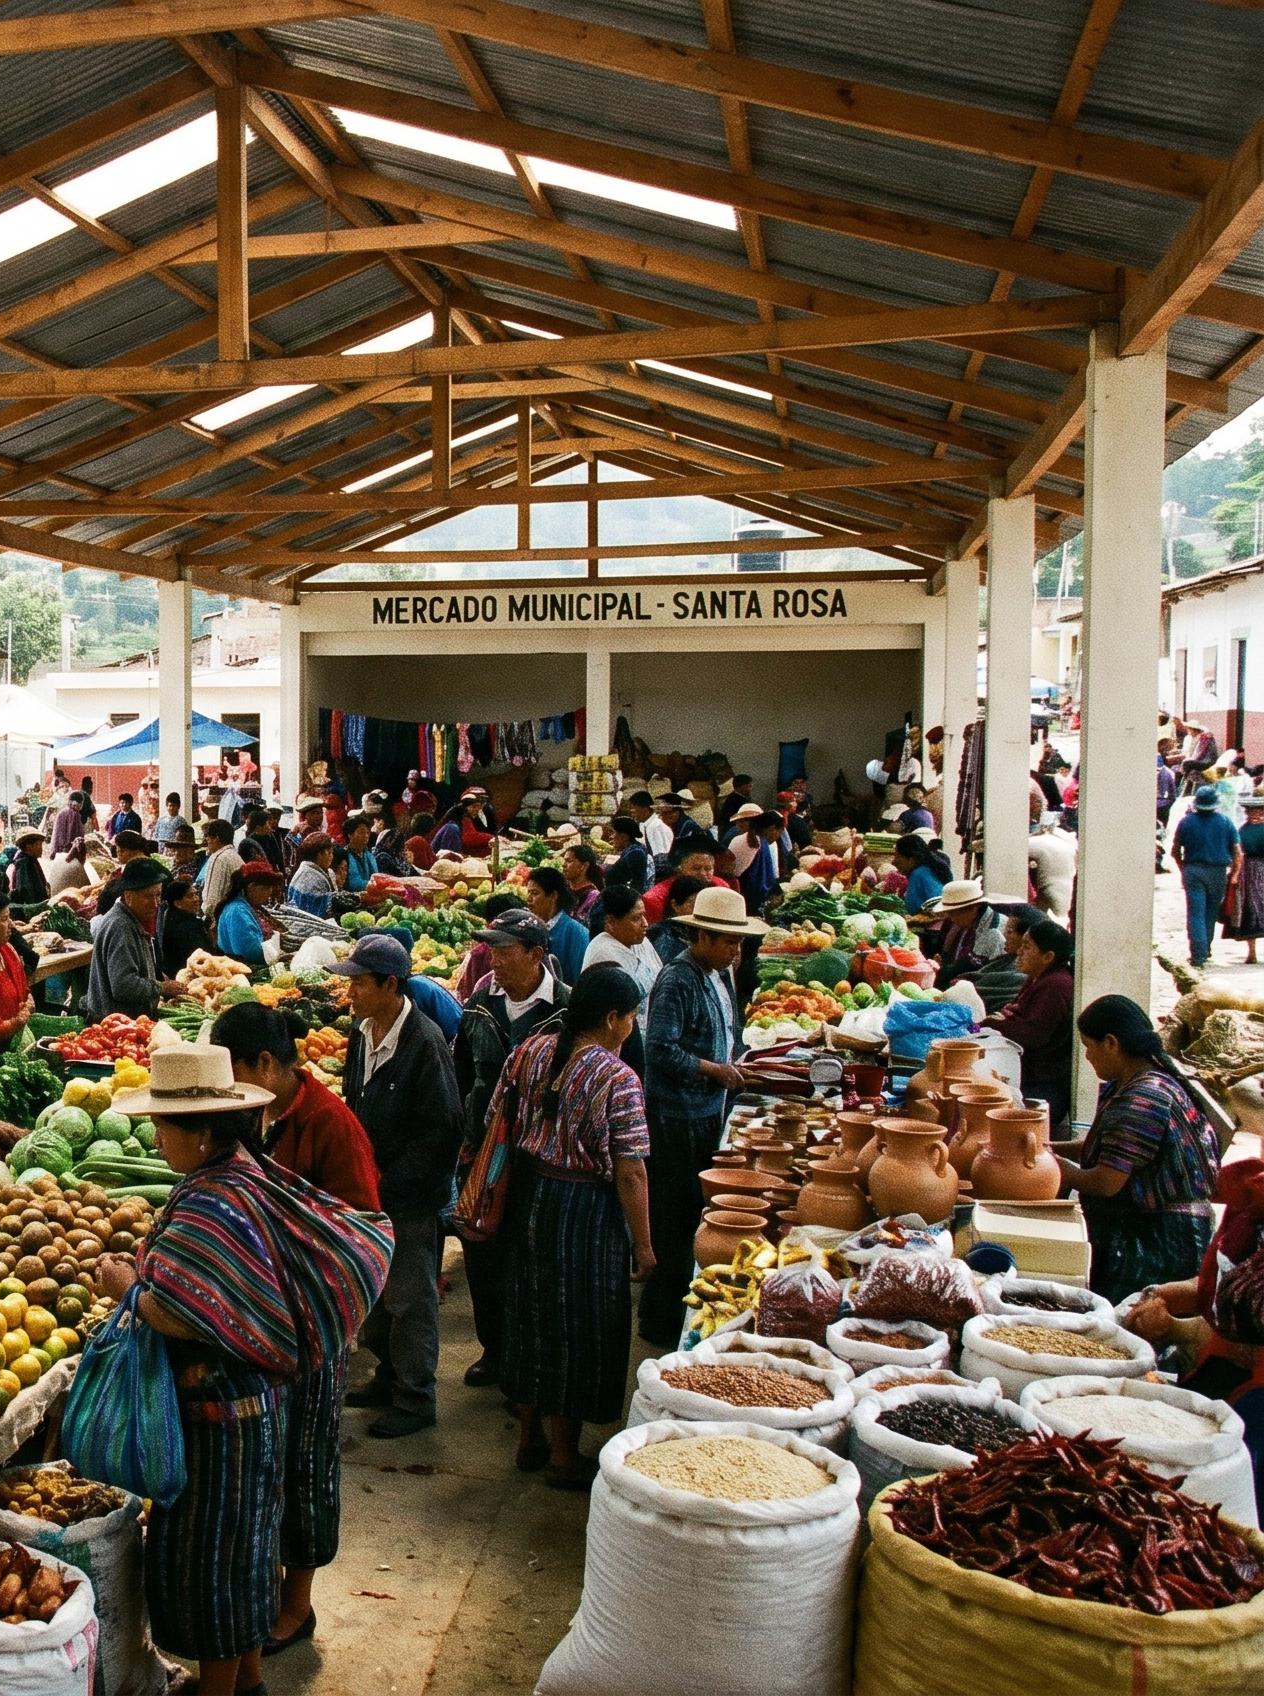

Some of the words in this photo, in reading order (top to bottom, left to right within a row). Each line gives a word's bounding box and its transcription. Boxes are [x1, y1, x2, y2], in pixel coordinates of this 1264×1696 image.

[372, 595, 497, 625] MERCADO
[508, 592, 652, 622] MUNICIPAL
[672, 590, 763, 620] SANTA
[773, 588, 848, 619] ROSA
